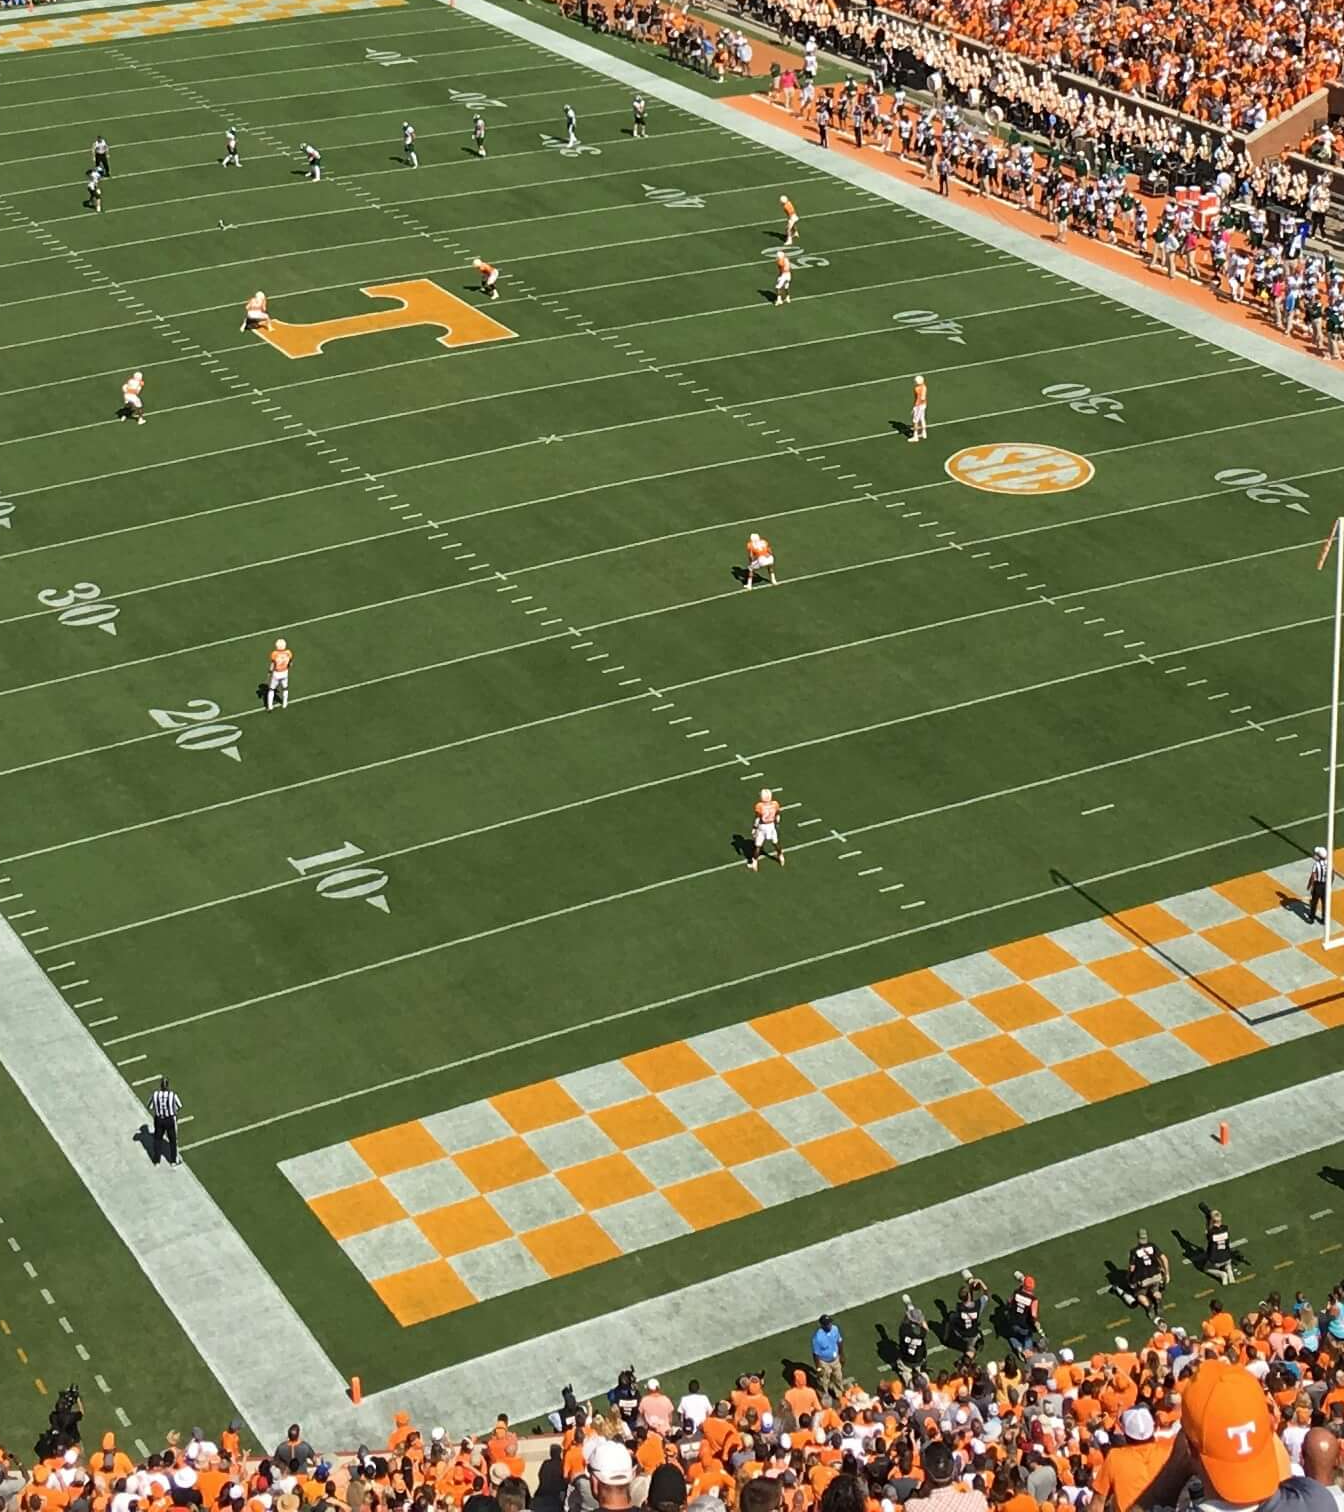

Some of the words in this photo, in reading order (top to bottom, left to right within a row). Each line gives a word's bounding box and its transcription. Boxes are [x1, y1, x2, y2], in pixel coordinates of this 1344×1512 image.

[644, 187, 707, 208] 40
[253, 278, 519, 359] T
[892, 309, 964, 334] 40
[1040, 383, 1125, 415] 30
[957, 446, 1082, 491] SEC
[1213, 467, 1311, 505] 20
[37, 581, 121, 627] 30
[148, 698, 244, 751] 20
[286, 840, 389, 900] 10
[1226, 1420, 1257, 1456] T
